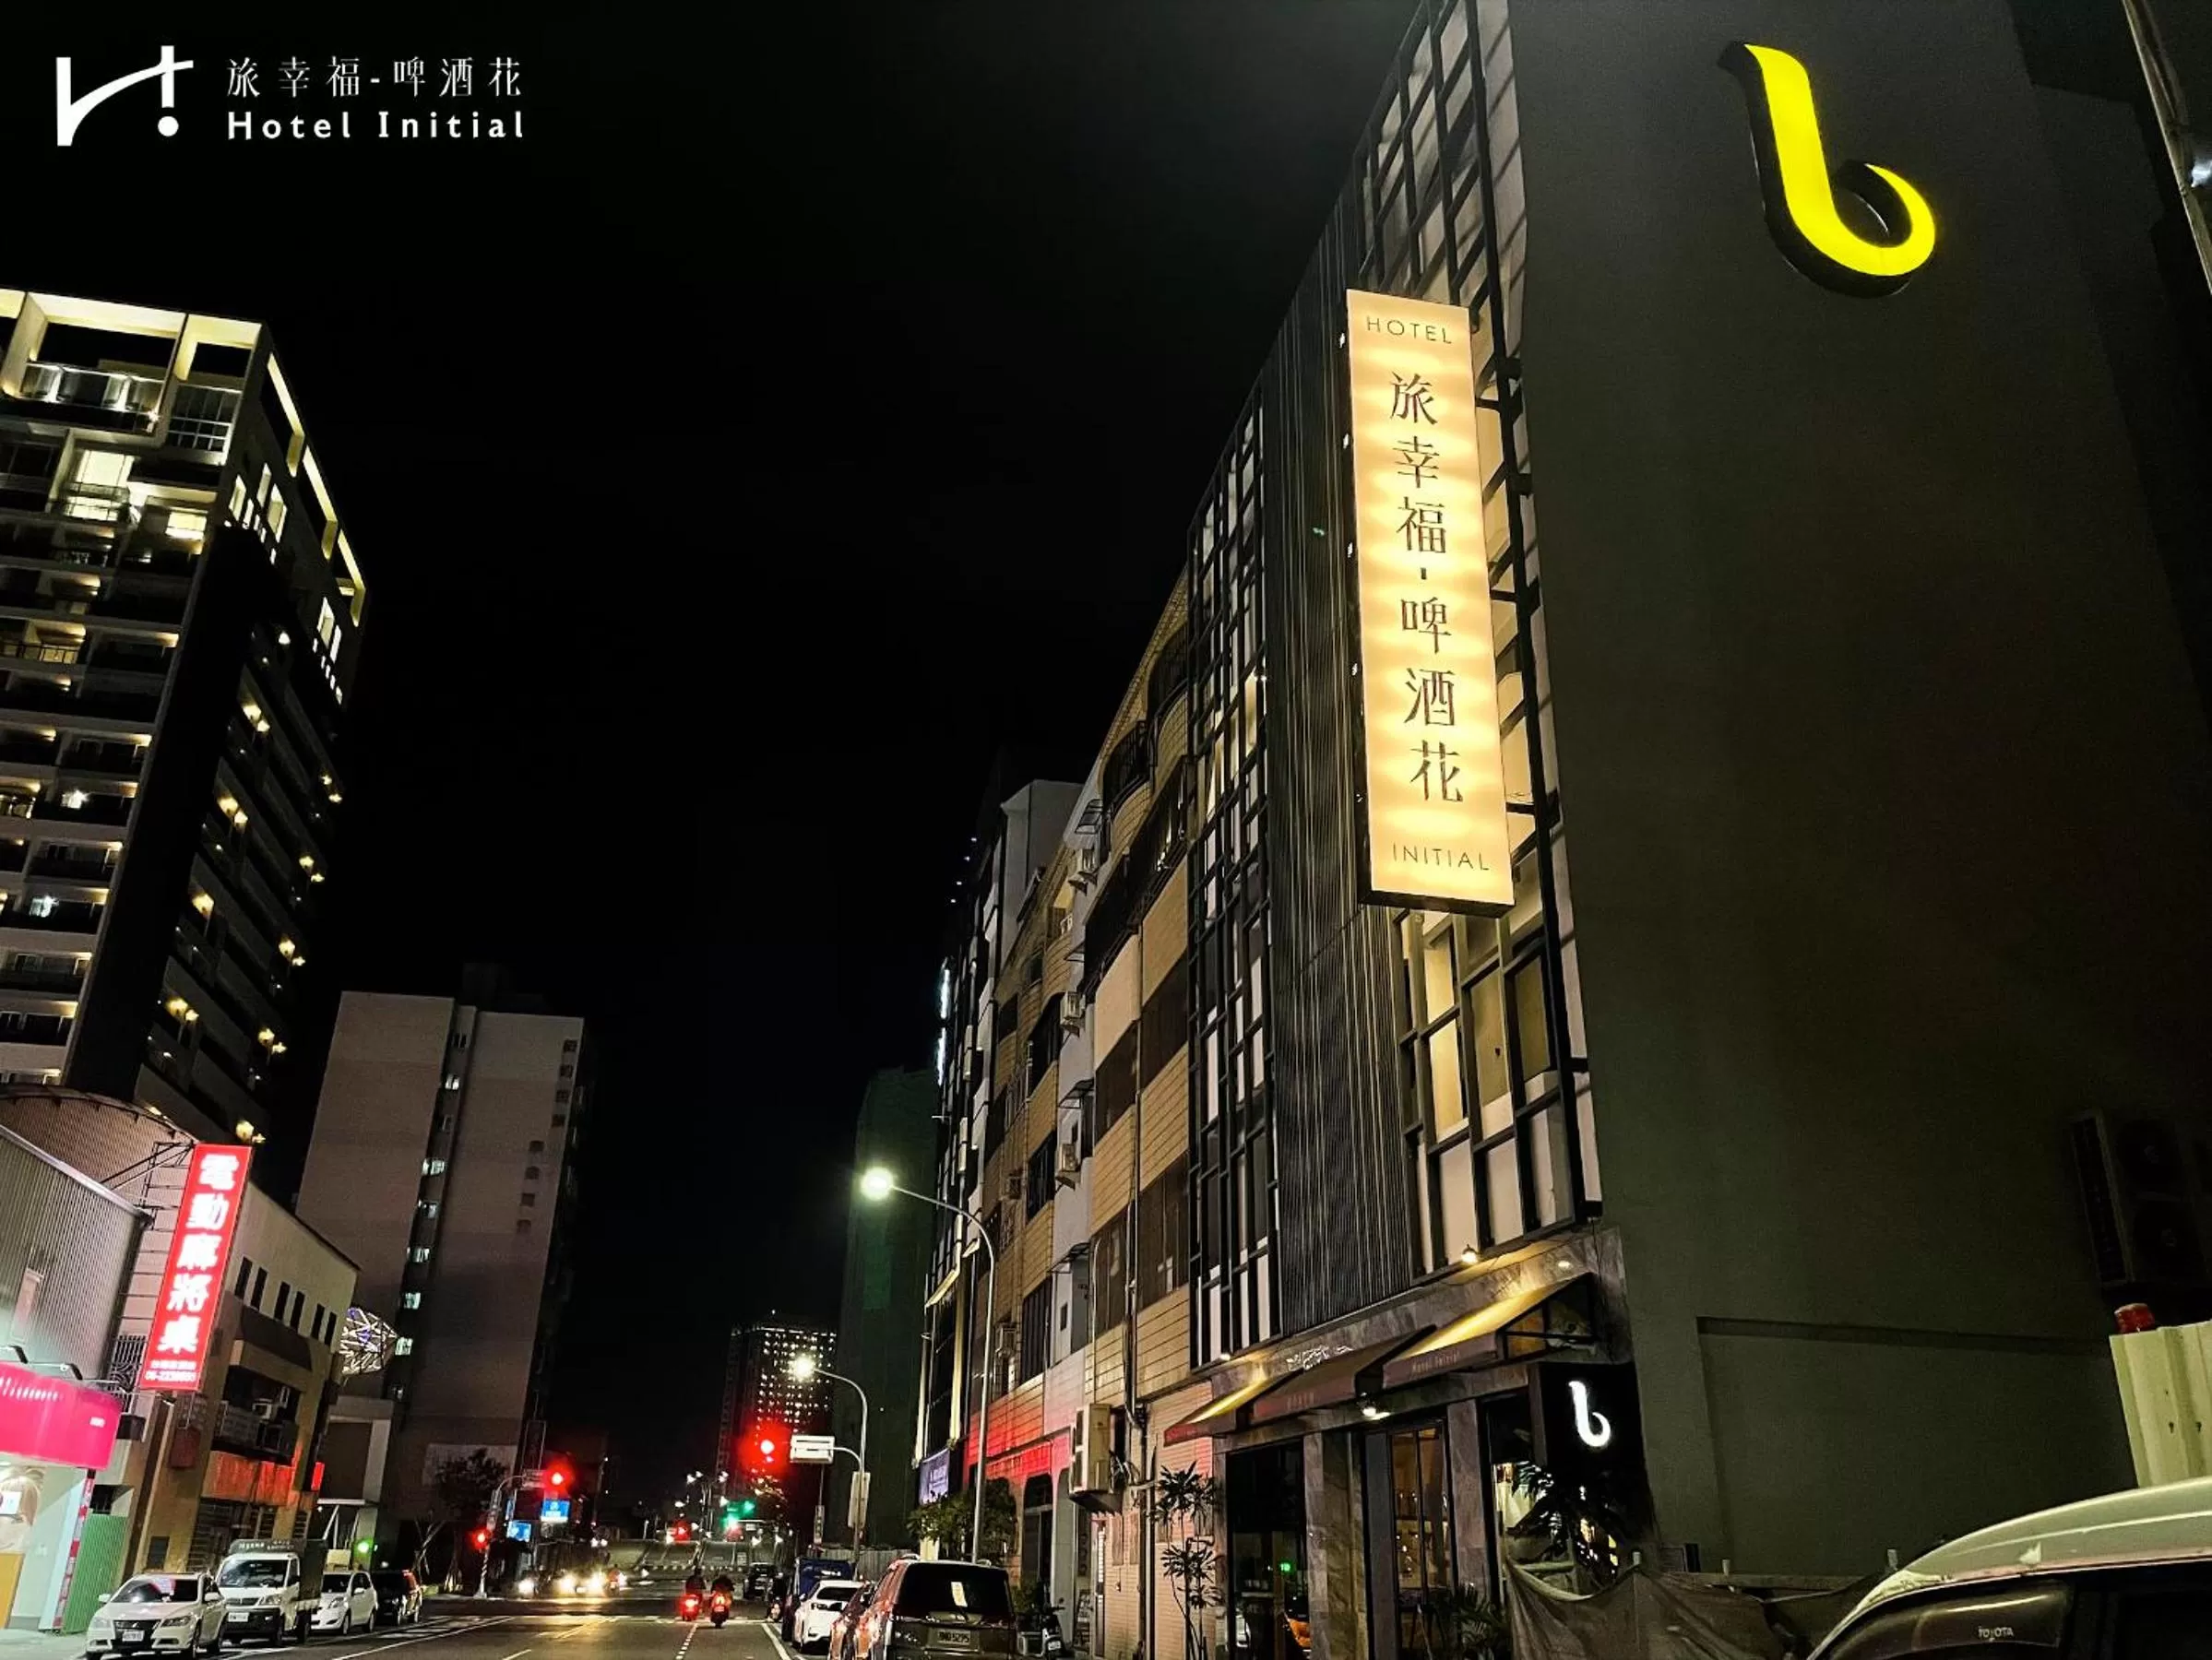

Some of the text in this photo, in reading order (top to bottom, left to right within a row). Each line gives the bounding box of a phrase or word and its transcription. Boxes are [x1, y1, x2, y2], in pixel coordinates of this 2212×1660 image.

[1366, 315, 1452, 344] HOTEL
[1393, 842, 1491, 872] INITIAL
[156, 1154, 240, 1354] 電動麻將桌
